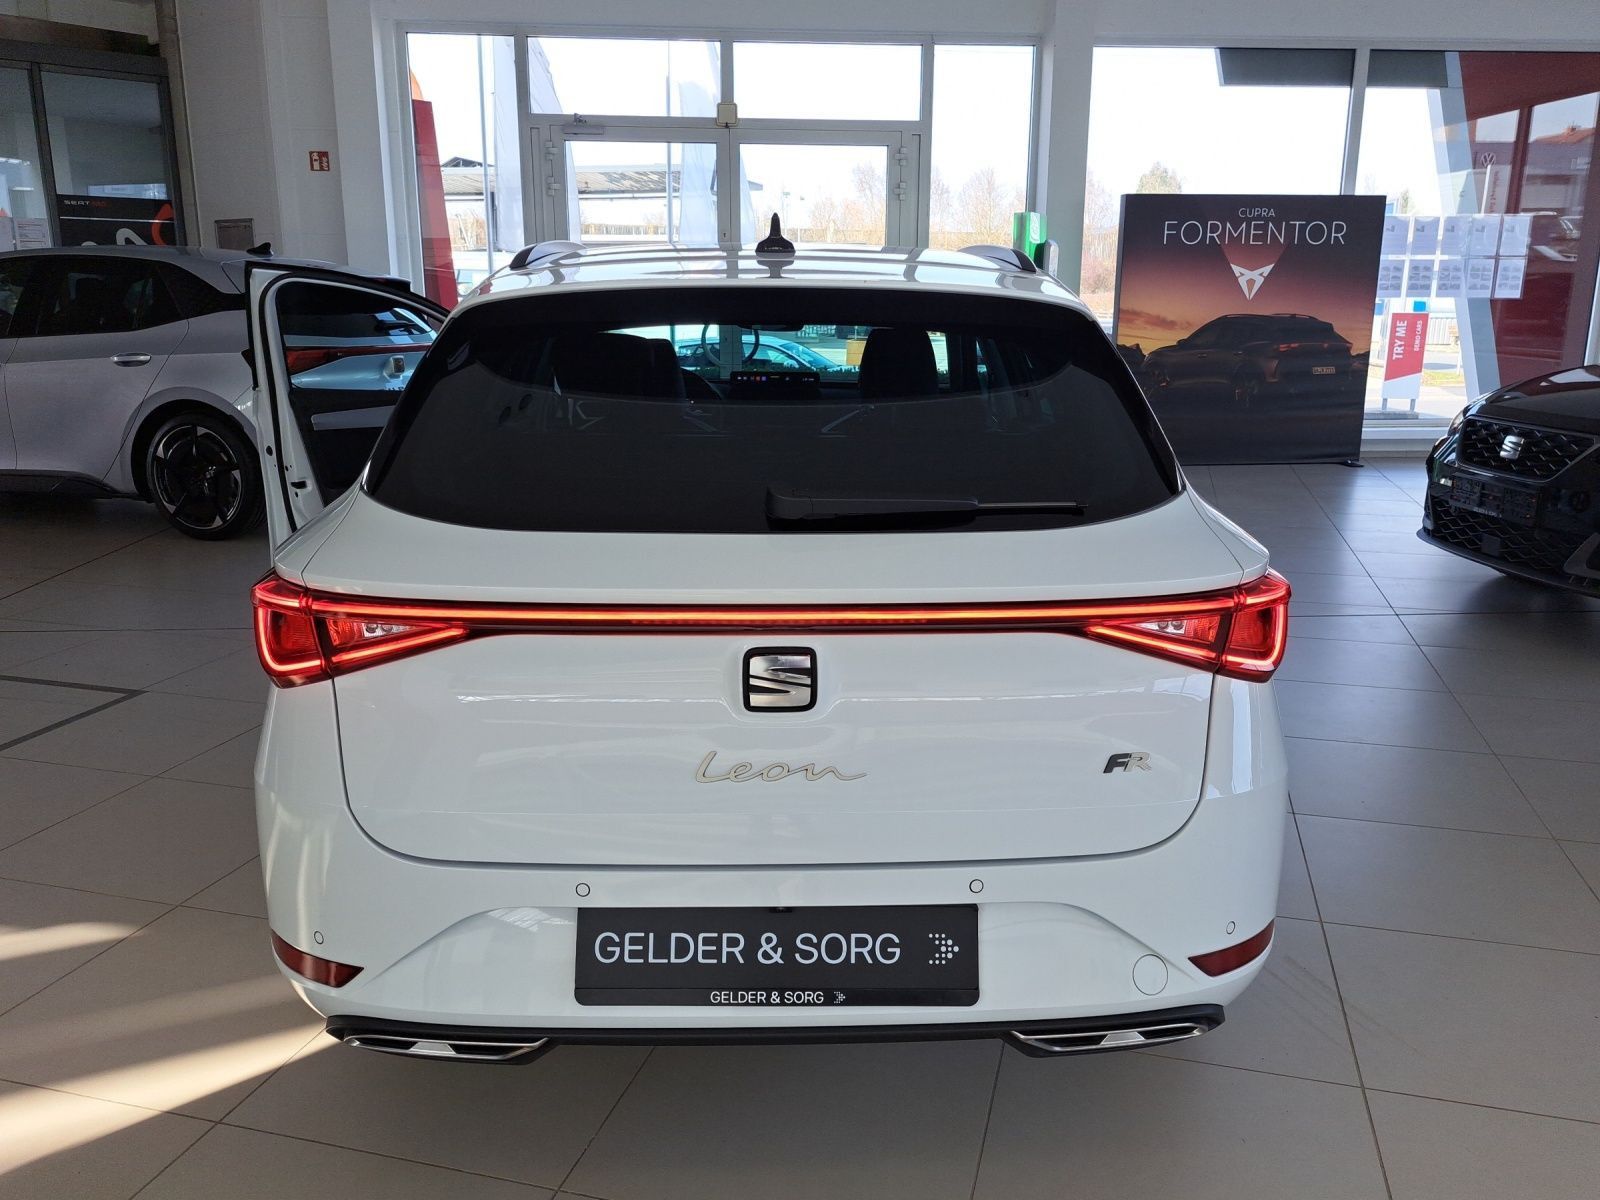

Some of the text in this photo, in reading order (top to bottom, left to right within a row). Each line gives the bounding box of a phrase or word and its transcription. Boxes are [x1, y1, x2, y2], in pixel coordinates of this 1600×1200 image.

[1238, 208, 1276, 218] CUPRA
[1163, 220, 1347, 245] FORMENTOR
[1392, 320, 1407, 360] TRY ME
[695, 750, 867, 783] Leon
[1103, 752, 1152, 773] FR
[594, 932, 901, 964] GELDER & SORG
[710, 991, 824, 1004] GELDER & SORG
